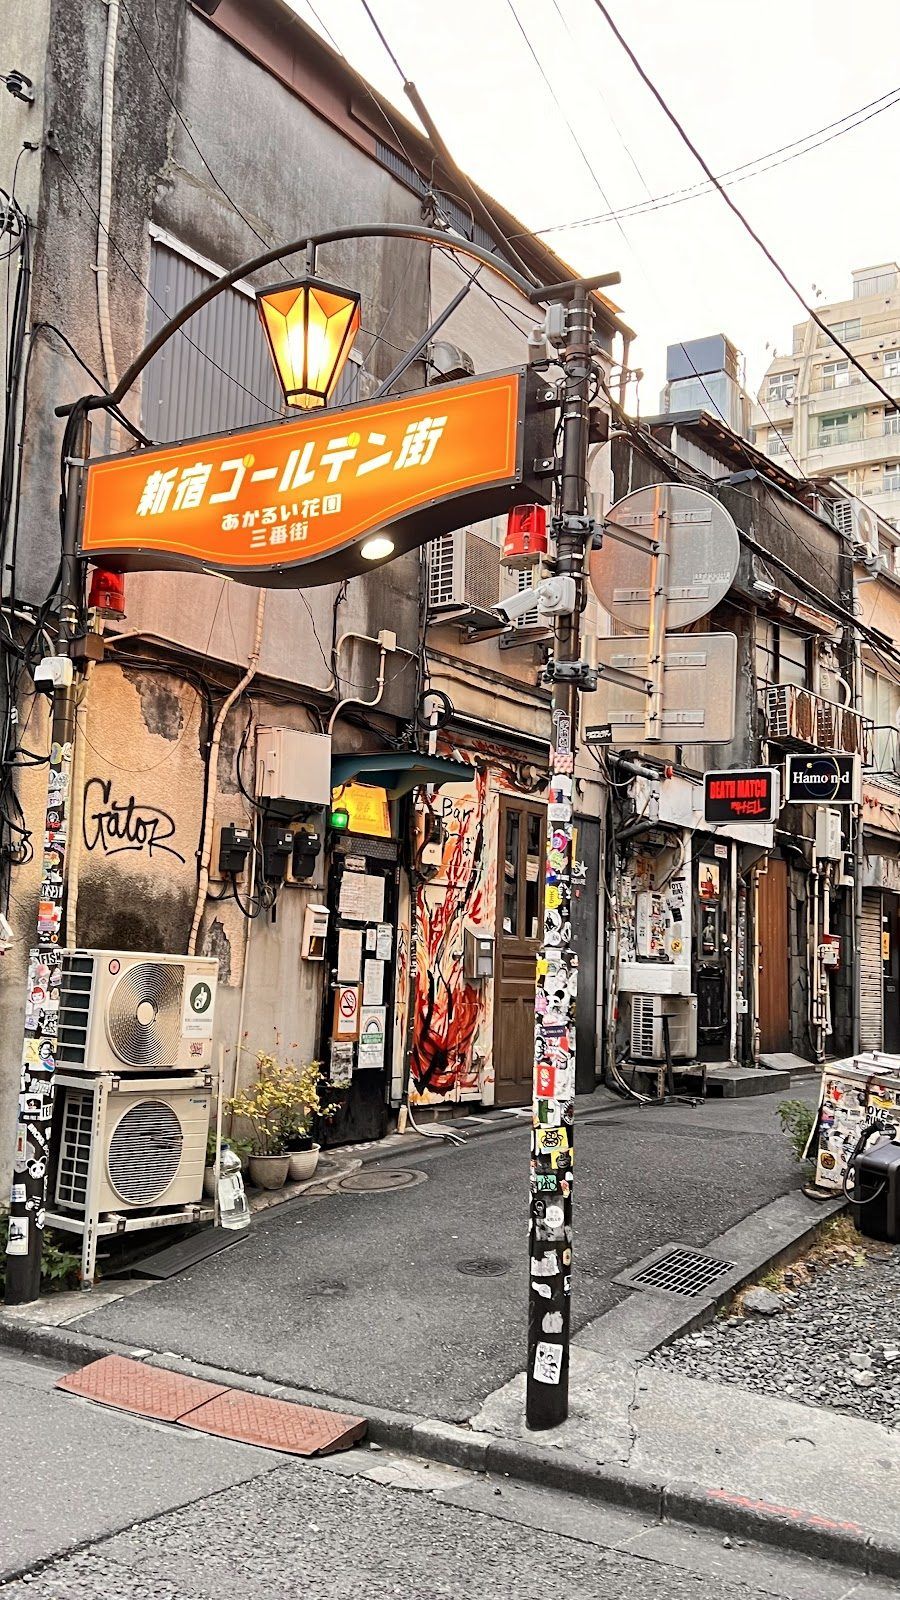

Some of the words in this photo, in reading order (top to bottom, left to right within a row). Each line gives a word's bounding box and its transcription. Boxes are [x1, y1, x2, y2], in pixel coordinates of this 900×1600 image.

[136, 415, 448, 517] 新宿ゴールデン街
[221, 493, 342, 532] あかるい花園
[249, 520, 309, 549] 三番街
[709, 780, 735, 800] DEATH
[736, 778, 767, 799] MATCH
[443, 797, 475, 822] Bar
